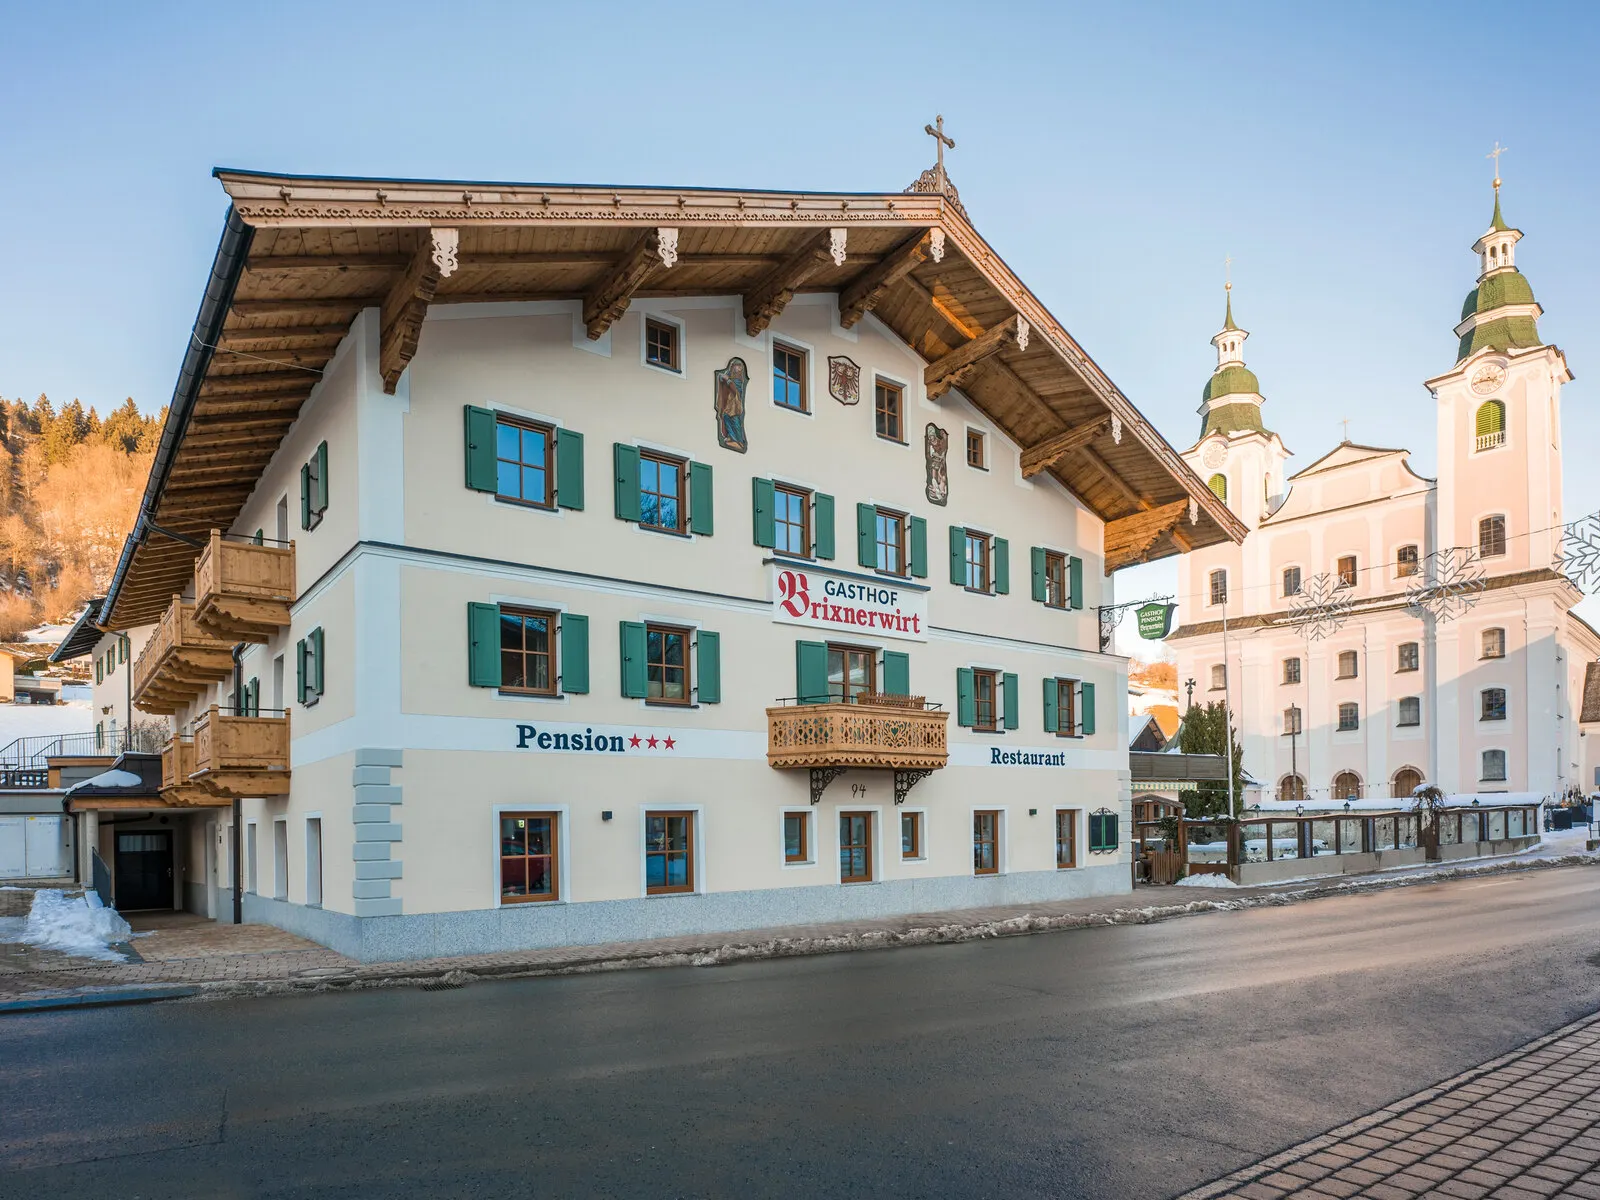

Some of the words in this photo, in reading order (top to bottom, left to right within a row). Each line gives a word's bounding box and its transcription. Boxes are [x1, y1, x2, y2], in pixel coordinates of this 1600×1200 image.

[778, 571, 921, 634] Brixnerwirt
[824, 580, 898, 606] GASTHOF
[1140, 609, 1164, 618] GASTHOF
[516, 724, 625, 752] Pension
[990, 747, 1066, 766] Restaurant
[851, 783, 866, 799] 94
